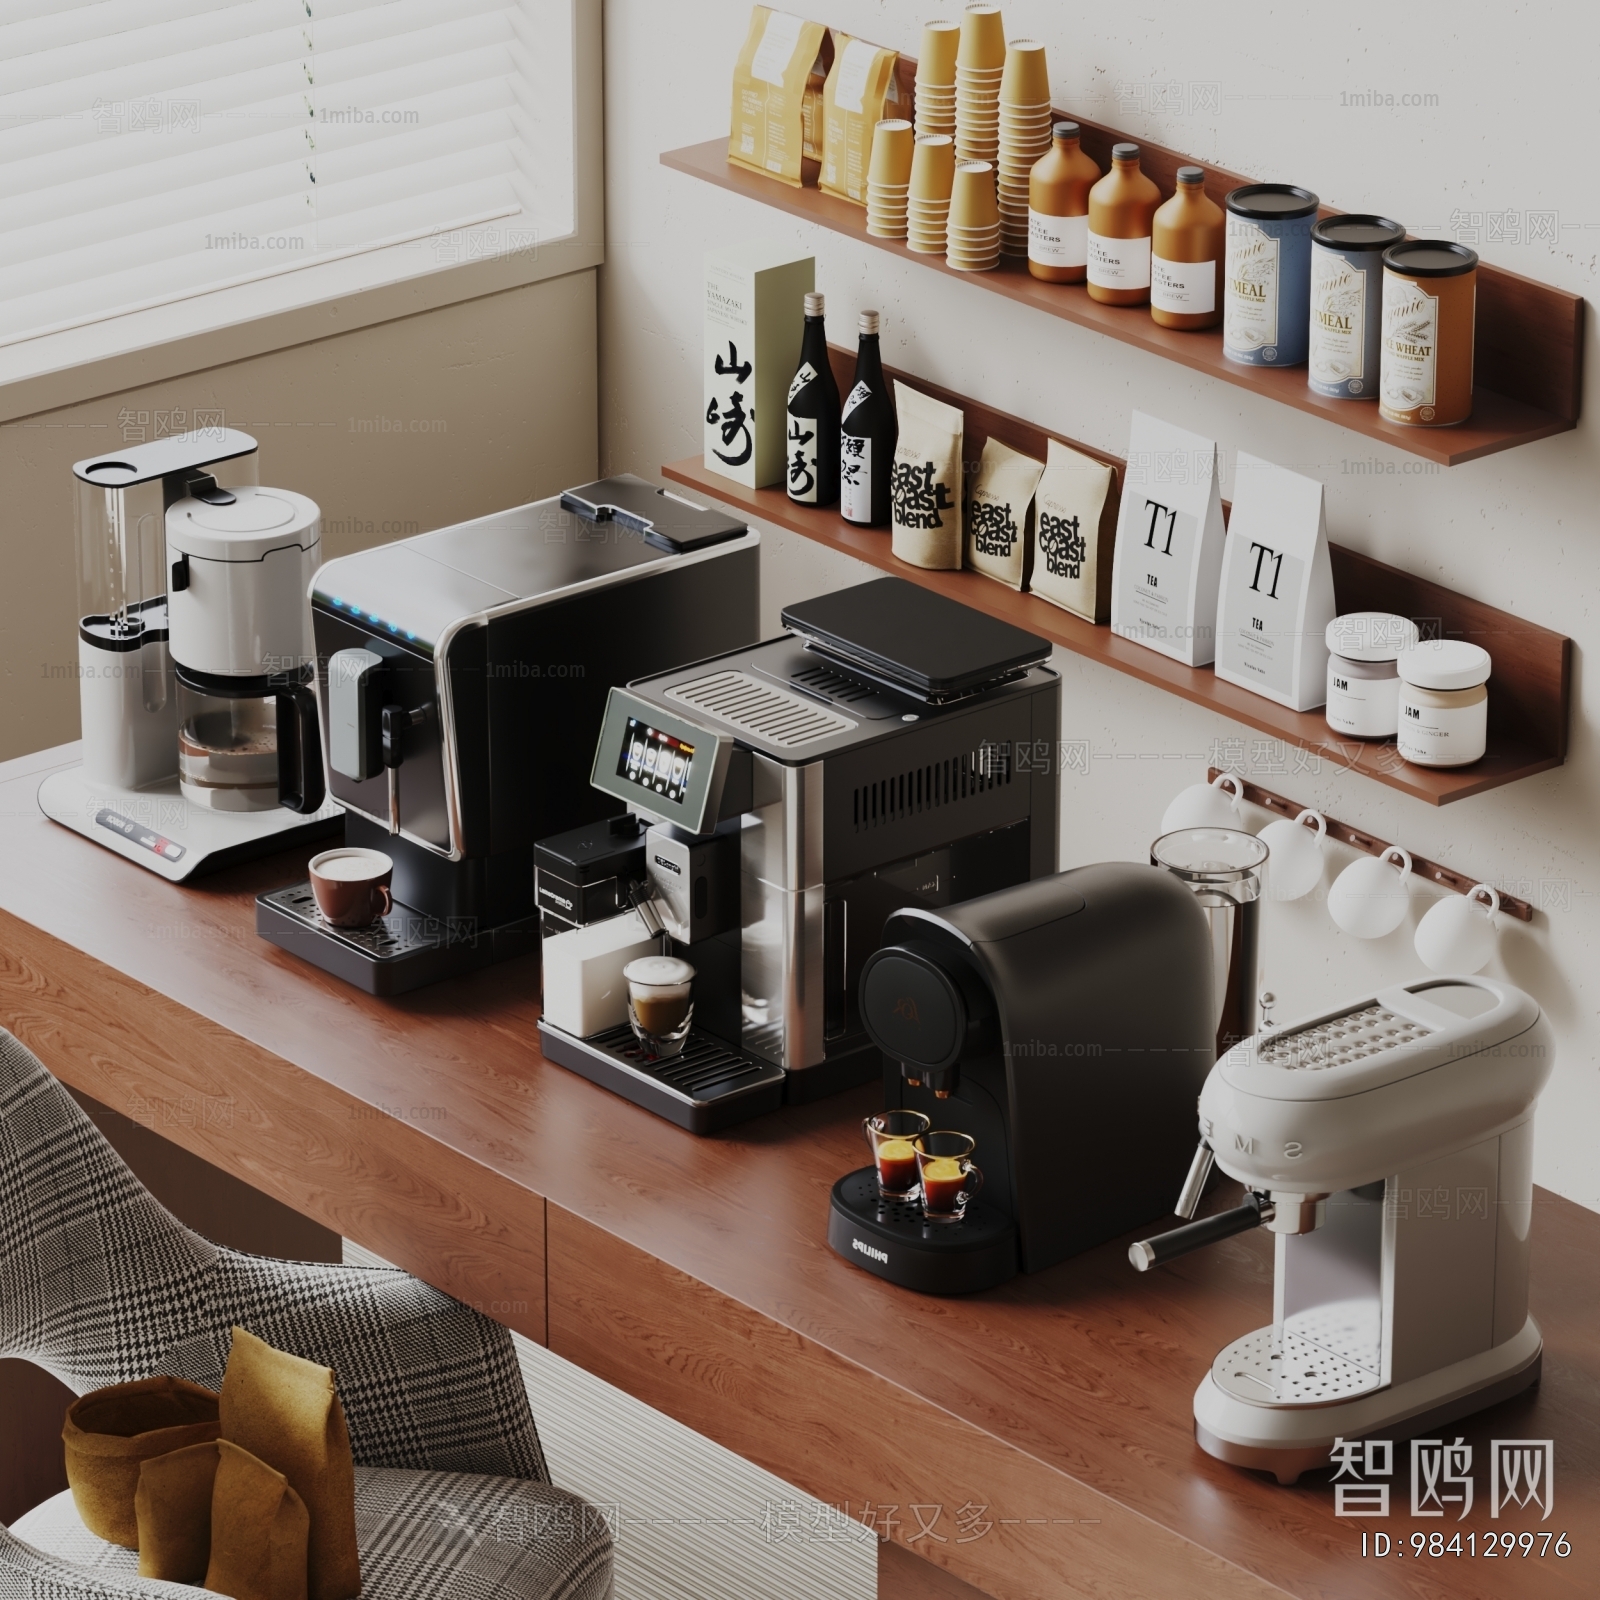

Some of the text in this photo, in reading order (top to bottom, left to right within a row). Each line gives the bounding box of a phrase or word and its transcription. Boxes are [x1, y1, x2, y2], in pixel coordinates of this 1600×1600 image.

[1030, 218, 1042, 227] ATE
[1030, 230, 1061, 243] ASTERS
[1089, 240, 1101, 249] ATE
[1089, 253, 1120, 265] ASTERS
[1153, 264, 1165, 273] ATE
[1154, 277, 1185, 289] ASTERS
[706, 290, 742, 310] YAMAZAKI
[1313, 308, 1353, 330] TMEAL
[1396, 342, 1432, 357] WHEAT
[894, 501, 943, 529] blend
[970, 500, 1011, 527] east
[970, 519, 1018, 543] coast
[1040, 512, 1080, 543] east
[1144, 499, 1177, 557] T1
[976, 535, 1011, 557] blend
[1039, 529, 1086, 562] coast
[1046, 552, 1080, 579] blend
[1249, 541, 1284, 600] T1
[1147, 573, 1158, 588] TEA
[1252, 617, 1263, 631] TEA
[1333, 676, 1348, 691] JAM
[1405, 705, 1420, 720] JAM
[1421, 730, 1450, 738] GINGER
